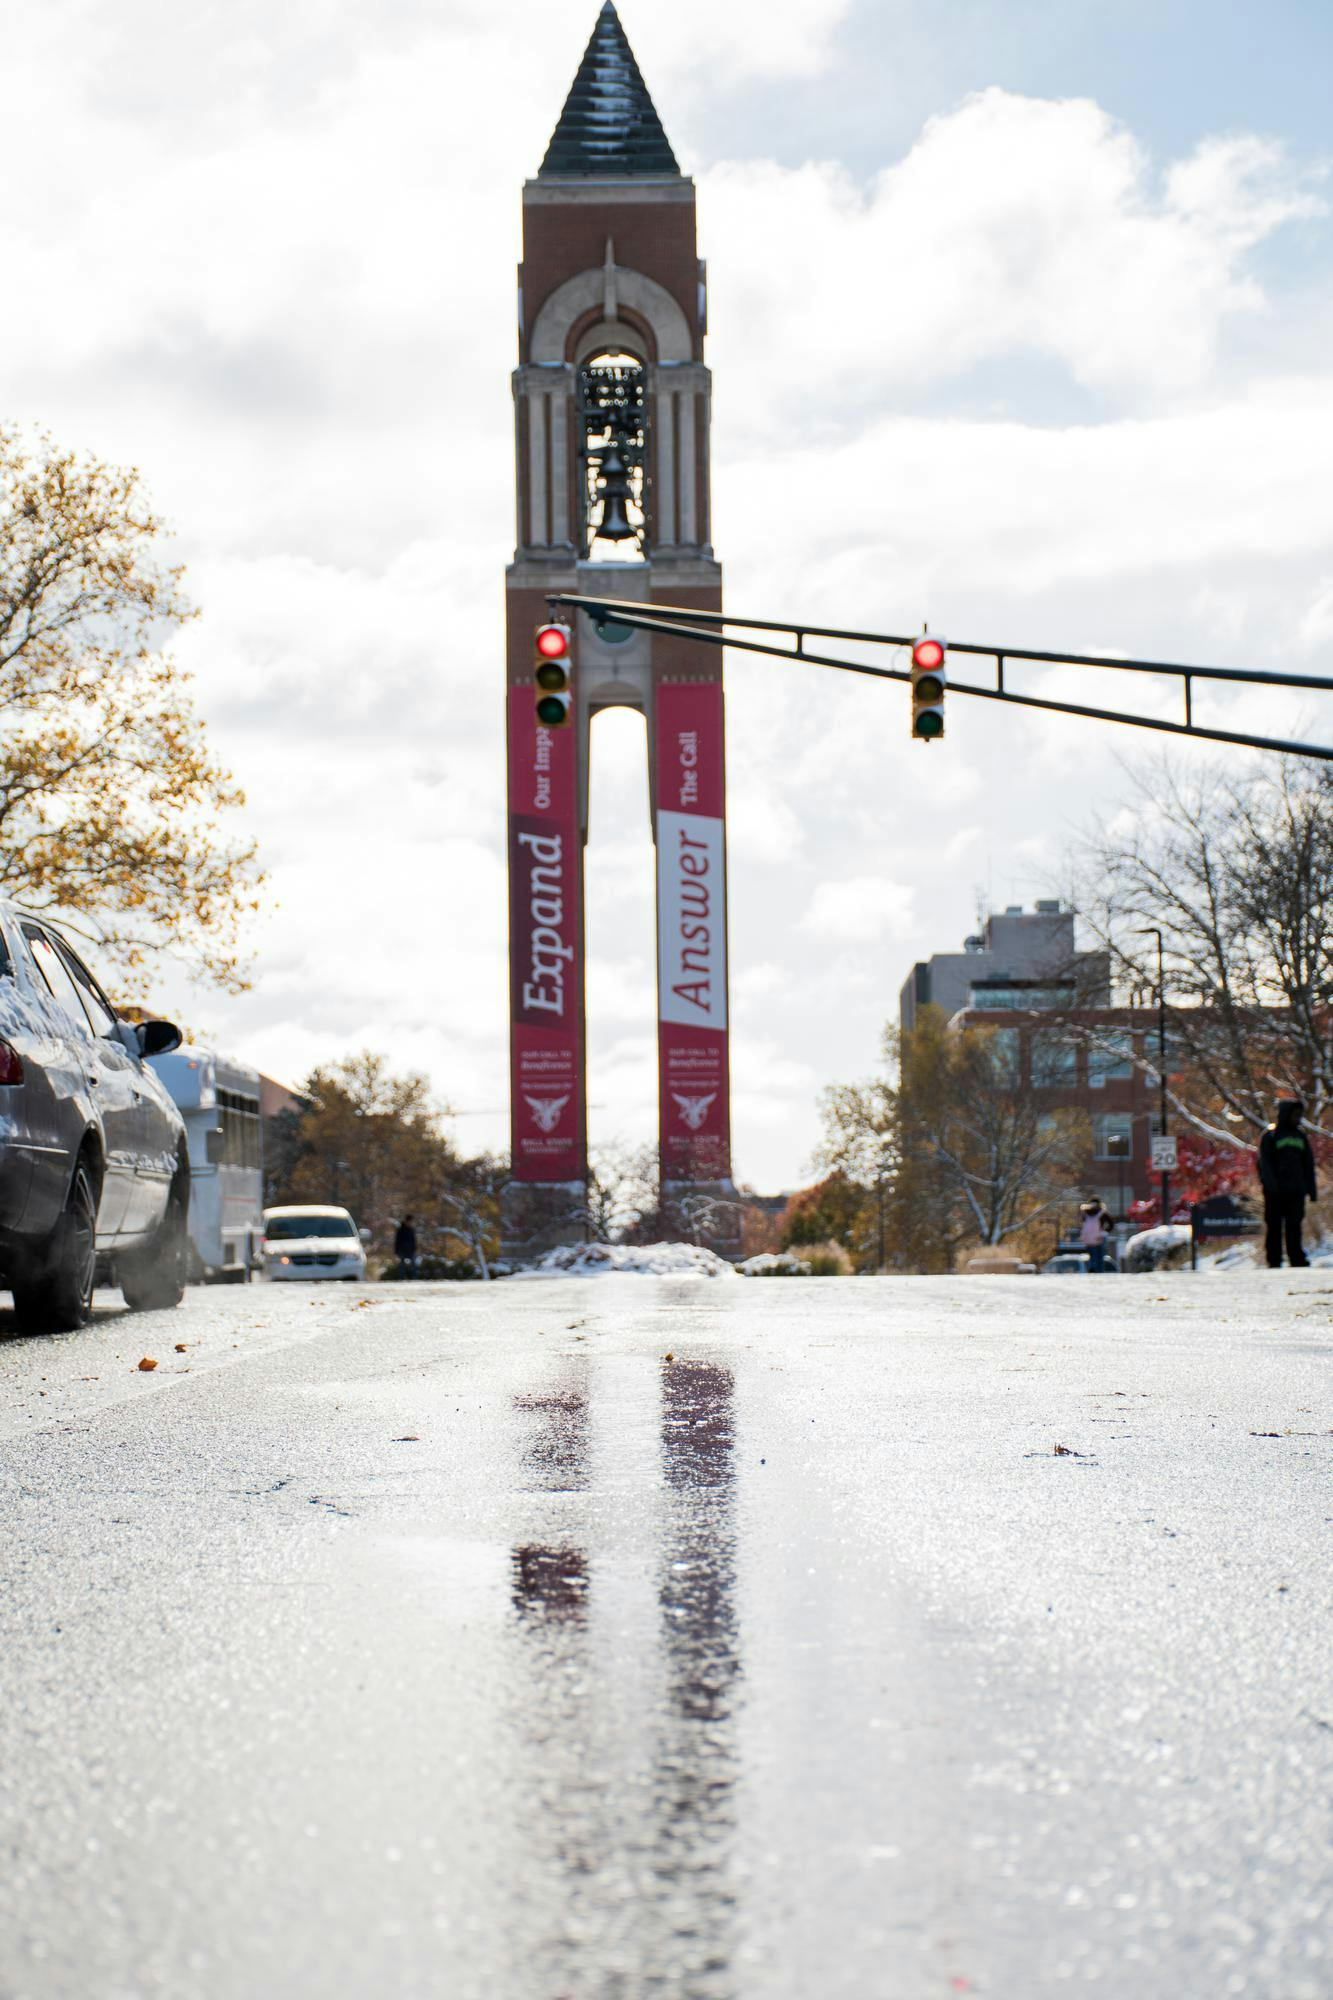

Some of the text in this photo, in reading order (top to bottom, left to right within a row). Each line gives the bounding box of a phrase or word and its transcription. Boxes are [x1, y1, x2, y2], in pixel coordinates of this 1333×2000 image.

[534, 727, 554, 809] Our Impa
[679, 731, 698, 807] The Call
[518, 832, 573, 1016] Expand
[671, 829, 711, 1014] Answer
[1154, 1153, 1176, 1166] 20
